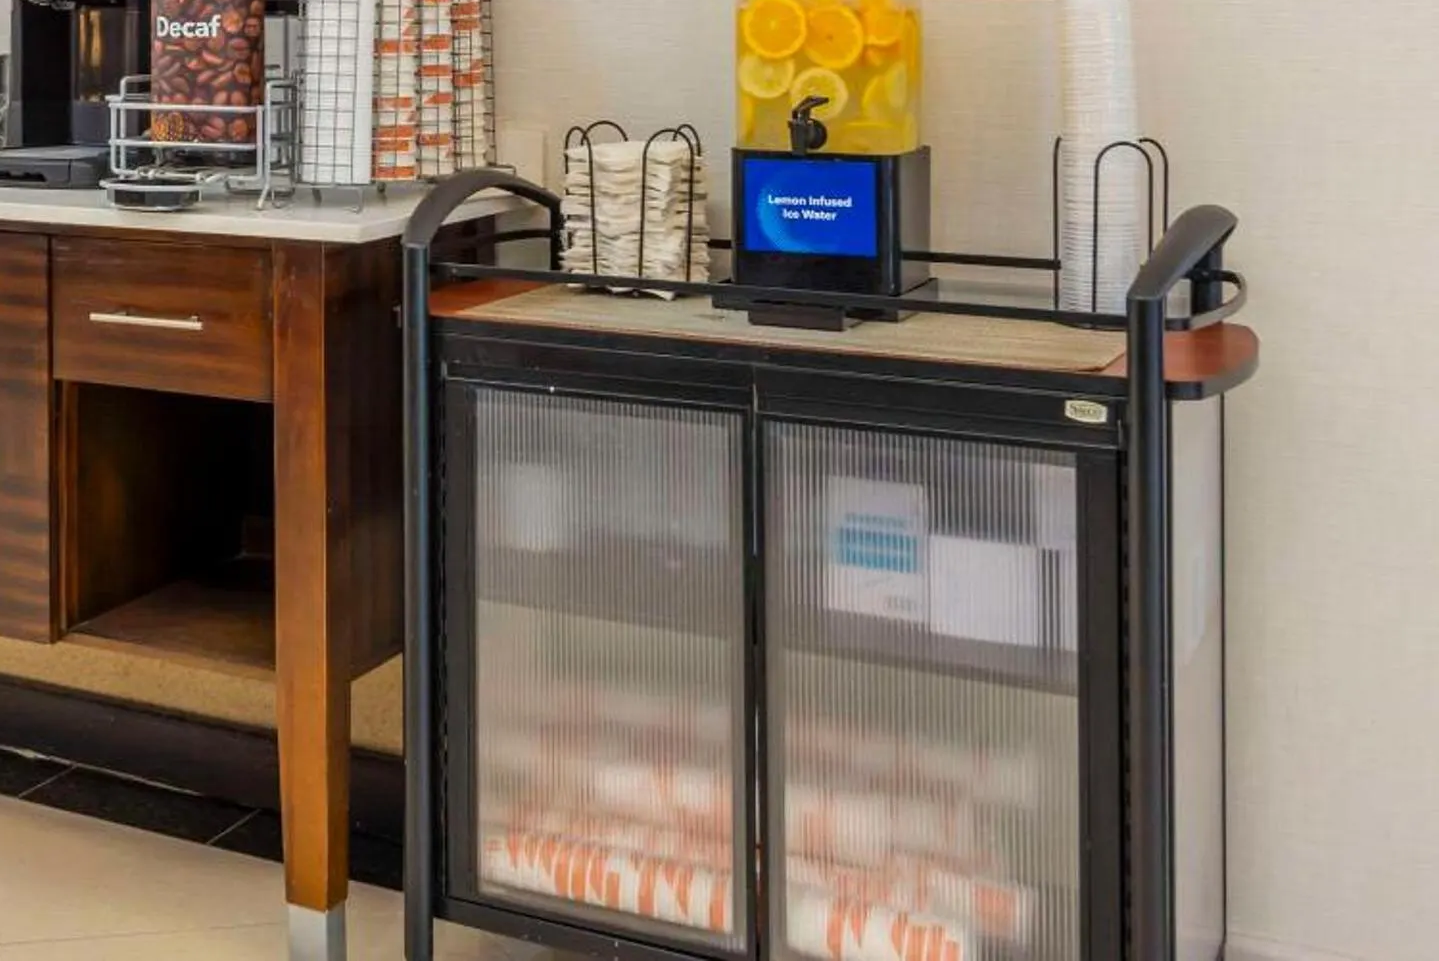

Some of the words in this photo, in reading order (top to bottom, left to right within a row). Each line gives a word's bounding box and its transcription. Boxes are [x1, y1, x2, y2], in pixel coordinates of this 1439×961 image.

[156, 14, 222, 38] Decaf
[768, 194, 806, 206] Lemon
[809, 195, 853, 207] Infused
[782, 208, 800, 219] Ice
[801, 209, 837, 221] Water
